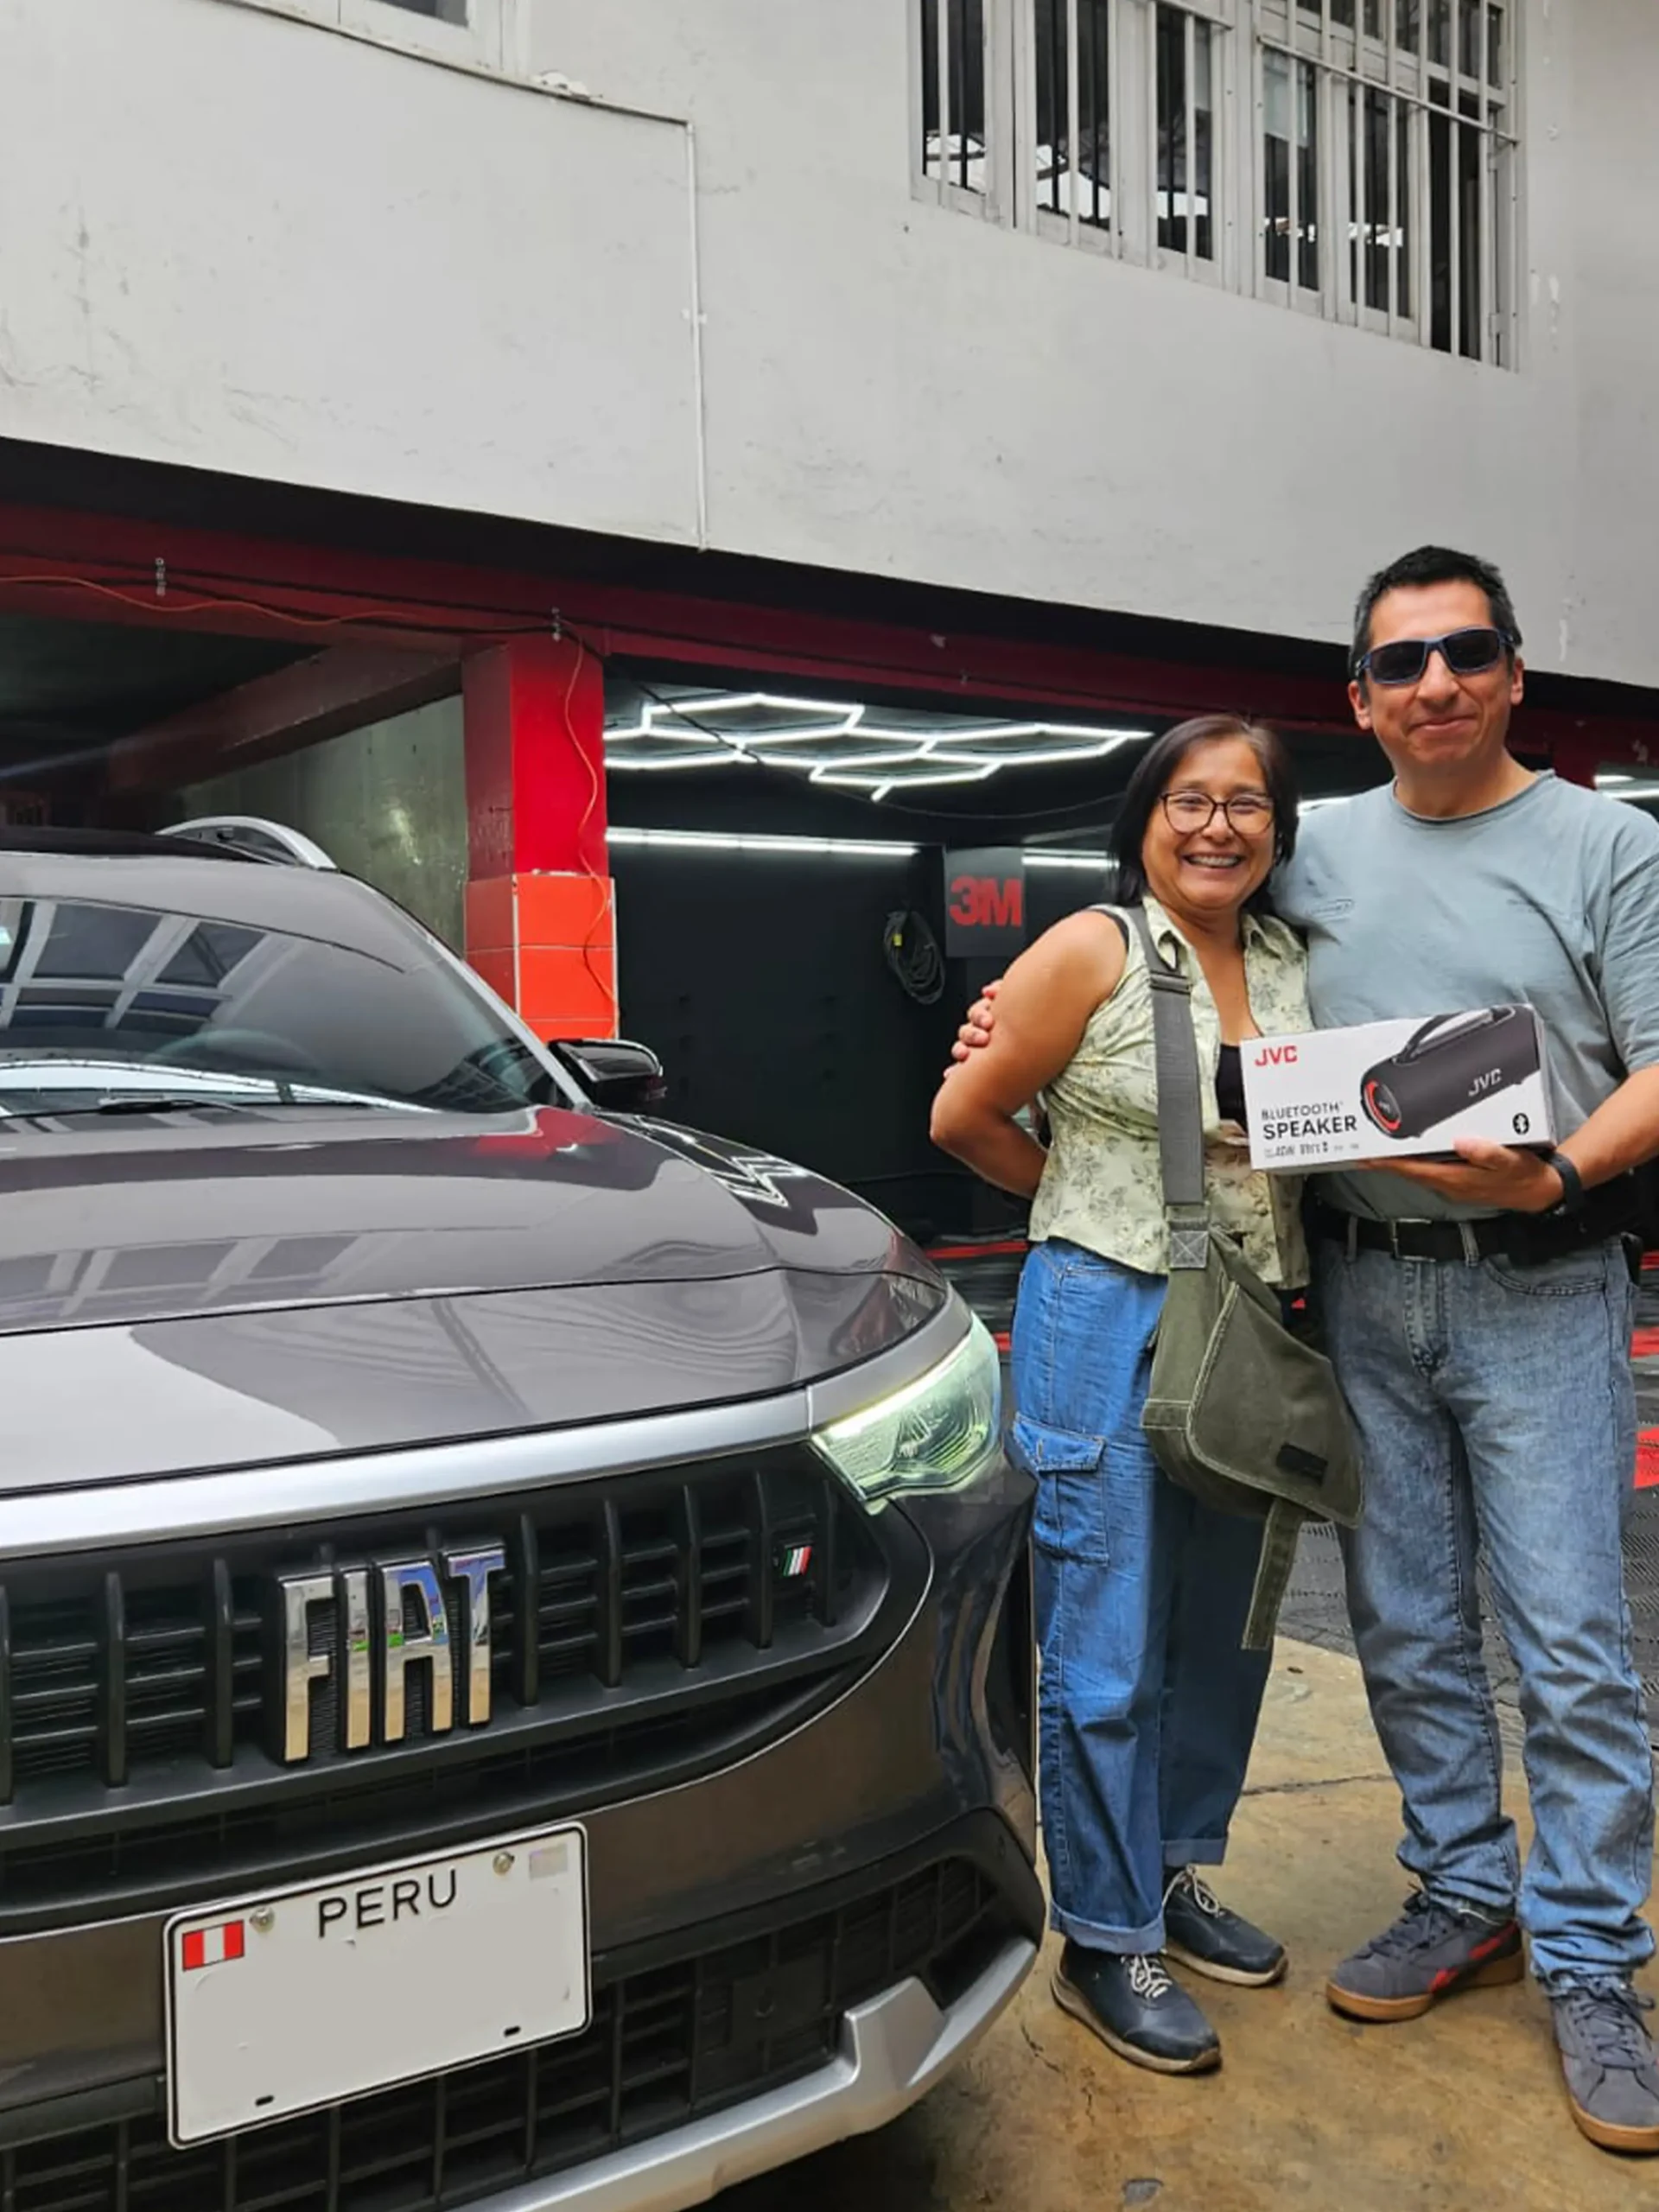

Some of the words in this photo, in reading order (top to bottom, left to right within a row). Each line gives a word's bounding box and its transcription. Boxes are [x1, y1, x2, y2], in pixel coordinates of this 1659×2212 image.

[950, 875, 1021, 926] 3M
[1255, 1046, 1298, 1066] JVC
[1469, 1068, 1502, 1096] JVC
[1263, 1115, 1357, 1140] SPEAKER
[282, 1548, 505, 1763] FIAT
[318, 1868, 457, 1938] PERU
